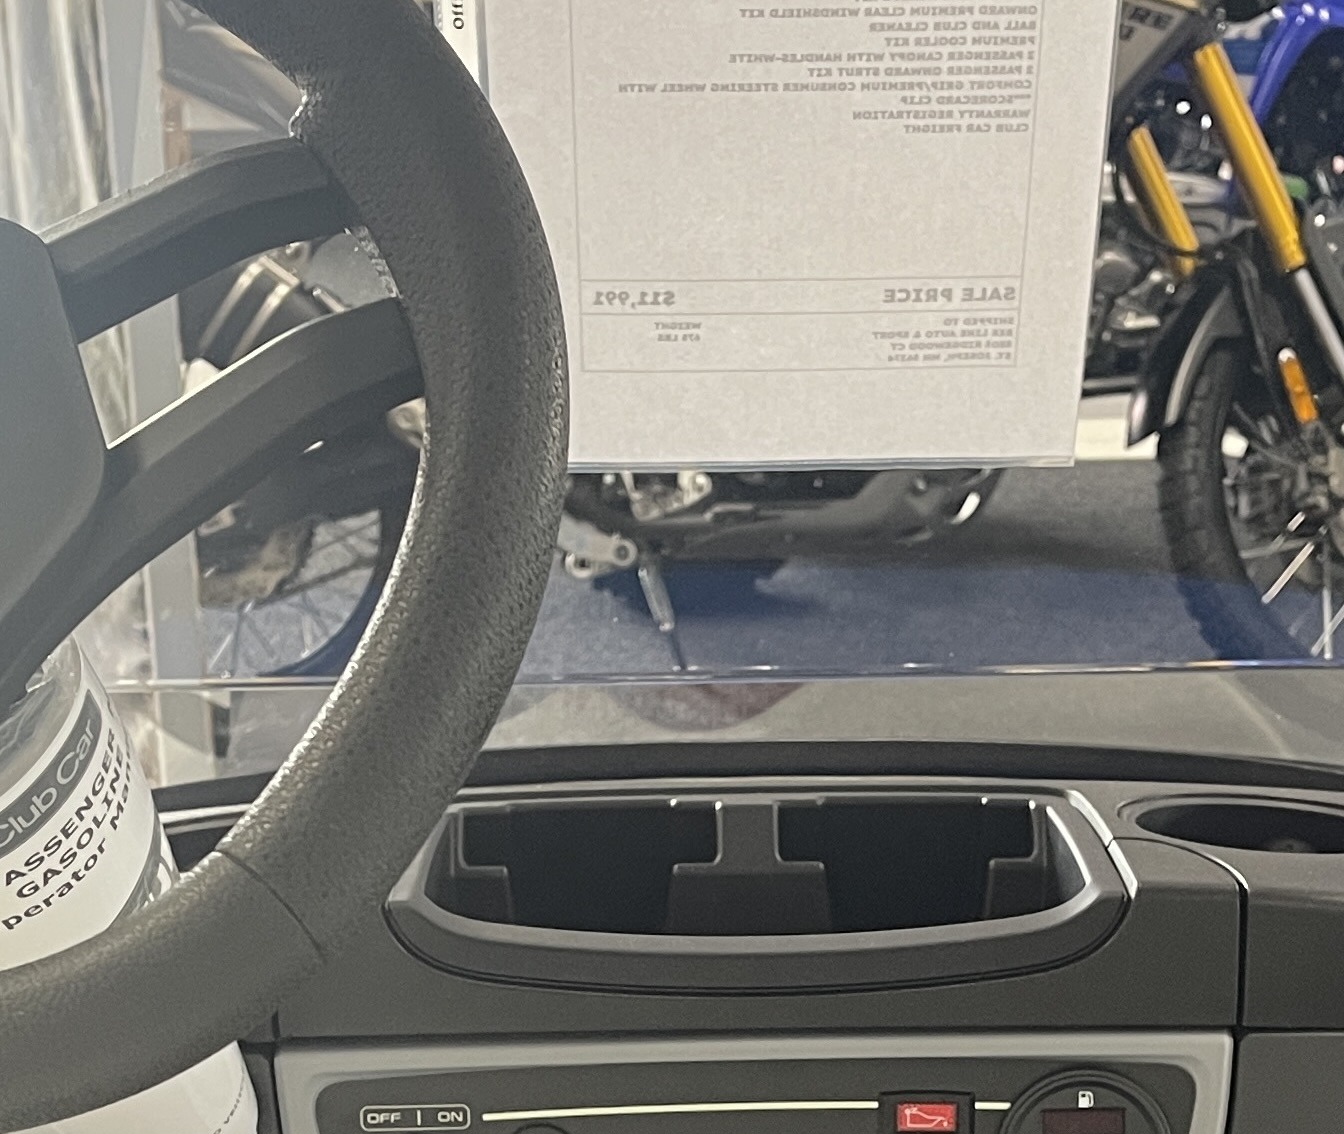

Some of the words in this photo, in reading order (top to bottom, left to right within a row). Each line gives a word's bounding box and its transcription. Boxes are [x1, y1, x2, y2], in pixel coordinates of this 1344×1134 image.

[57, 719, 94, 785] Car
[16, 744, 123, 898] GASOLINE
[366, 1112, 401, 1124] OFF
[437, 1111, 464, 1123] ON
